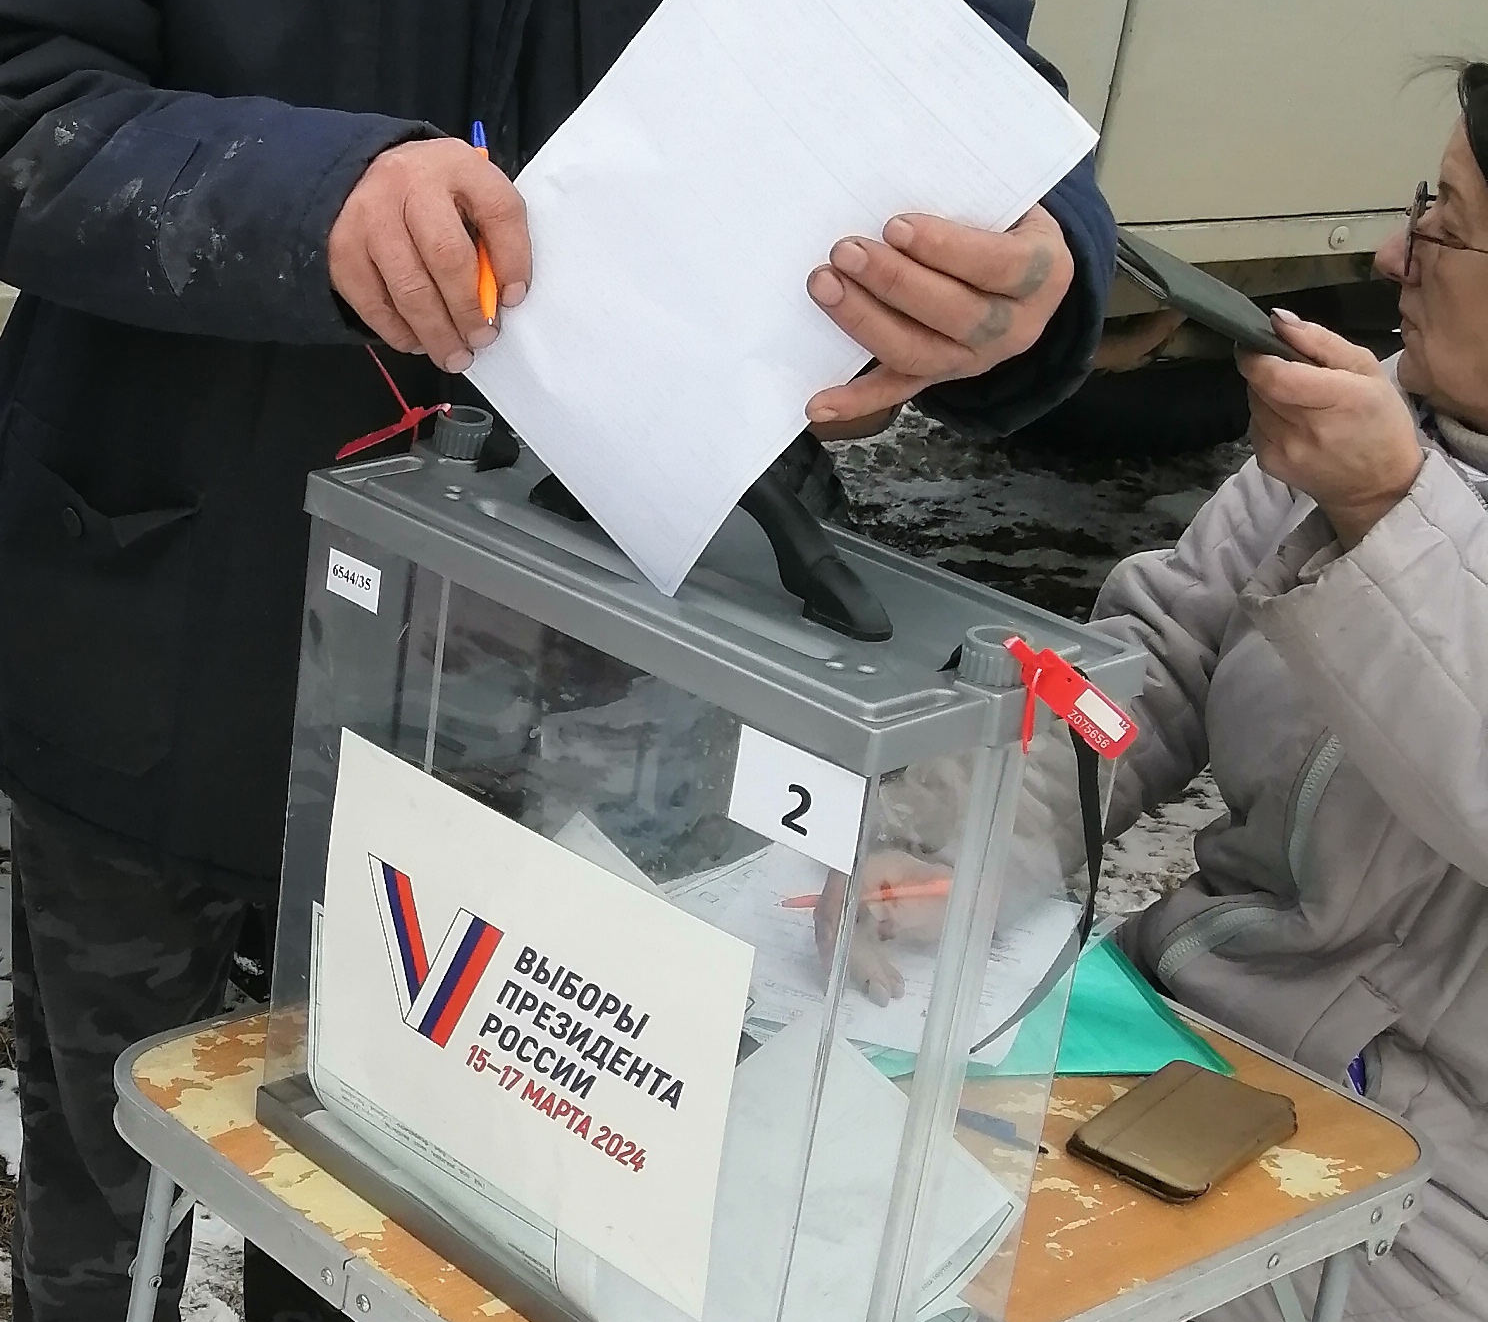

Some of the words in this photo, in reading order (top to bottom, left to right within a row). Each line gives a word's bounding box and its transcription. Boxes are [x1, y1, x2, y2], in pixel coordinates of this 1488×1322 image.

[333, 564, 372, 591] 6544/35
[781, 784, 812, 836] 2
[514, 946, 650, 1039] ВЫБОРЫ
[479, 1013, 597, 1100] РОССИИ
[496, 979, 684, 1110] ПРЕЗИДЕНТА
[520, 1079, 592, 1140] МАРТА
[591, 1126, 647, 1173] 2024
